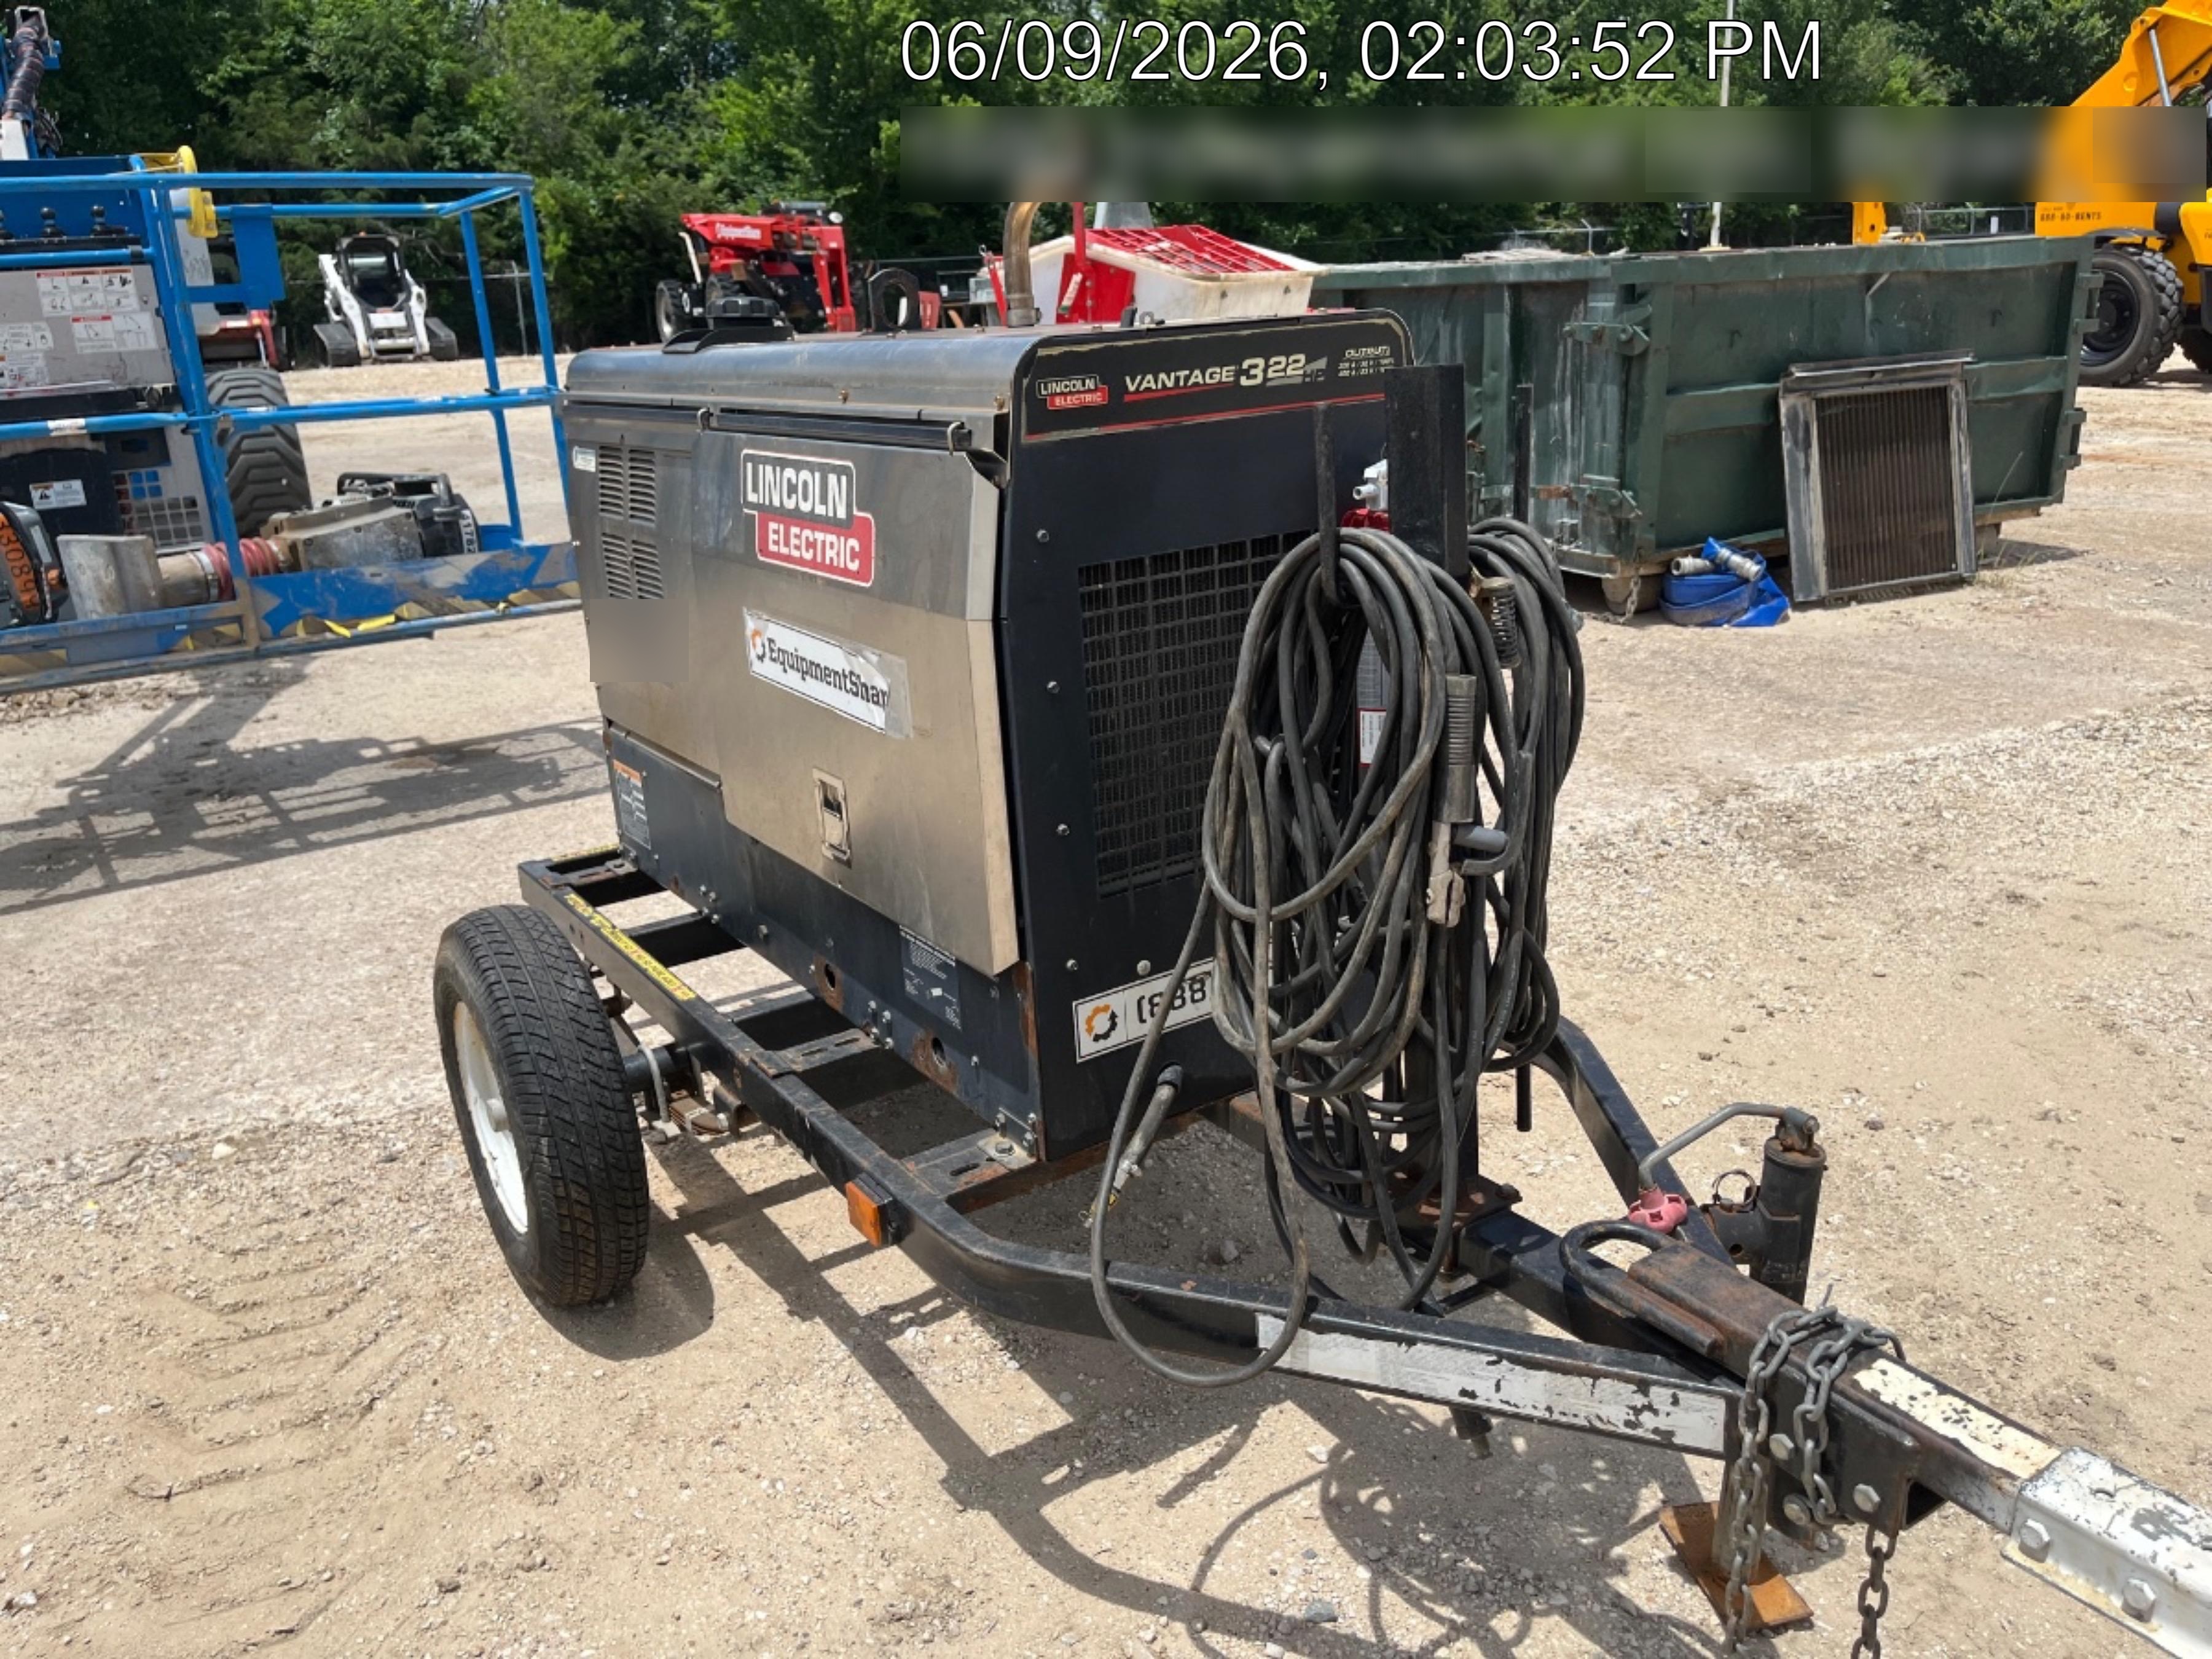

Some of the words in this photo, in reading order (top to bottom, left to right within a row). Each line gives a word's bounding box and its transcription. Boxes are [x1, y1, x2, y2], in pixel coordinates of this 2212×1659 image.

[1040, 377, 1096, 395] LINCOLN
[1124, 366, 1236, 392] VANTAGE
[1240, 353, 1306, 386] 322
[1054, 392, 1103, 406] ELECTRIC
[746, 462, 847, 520] LINCOLN
[768, 521, 860, 571] ELECTRIC
